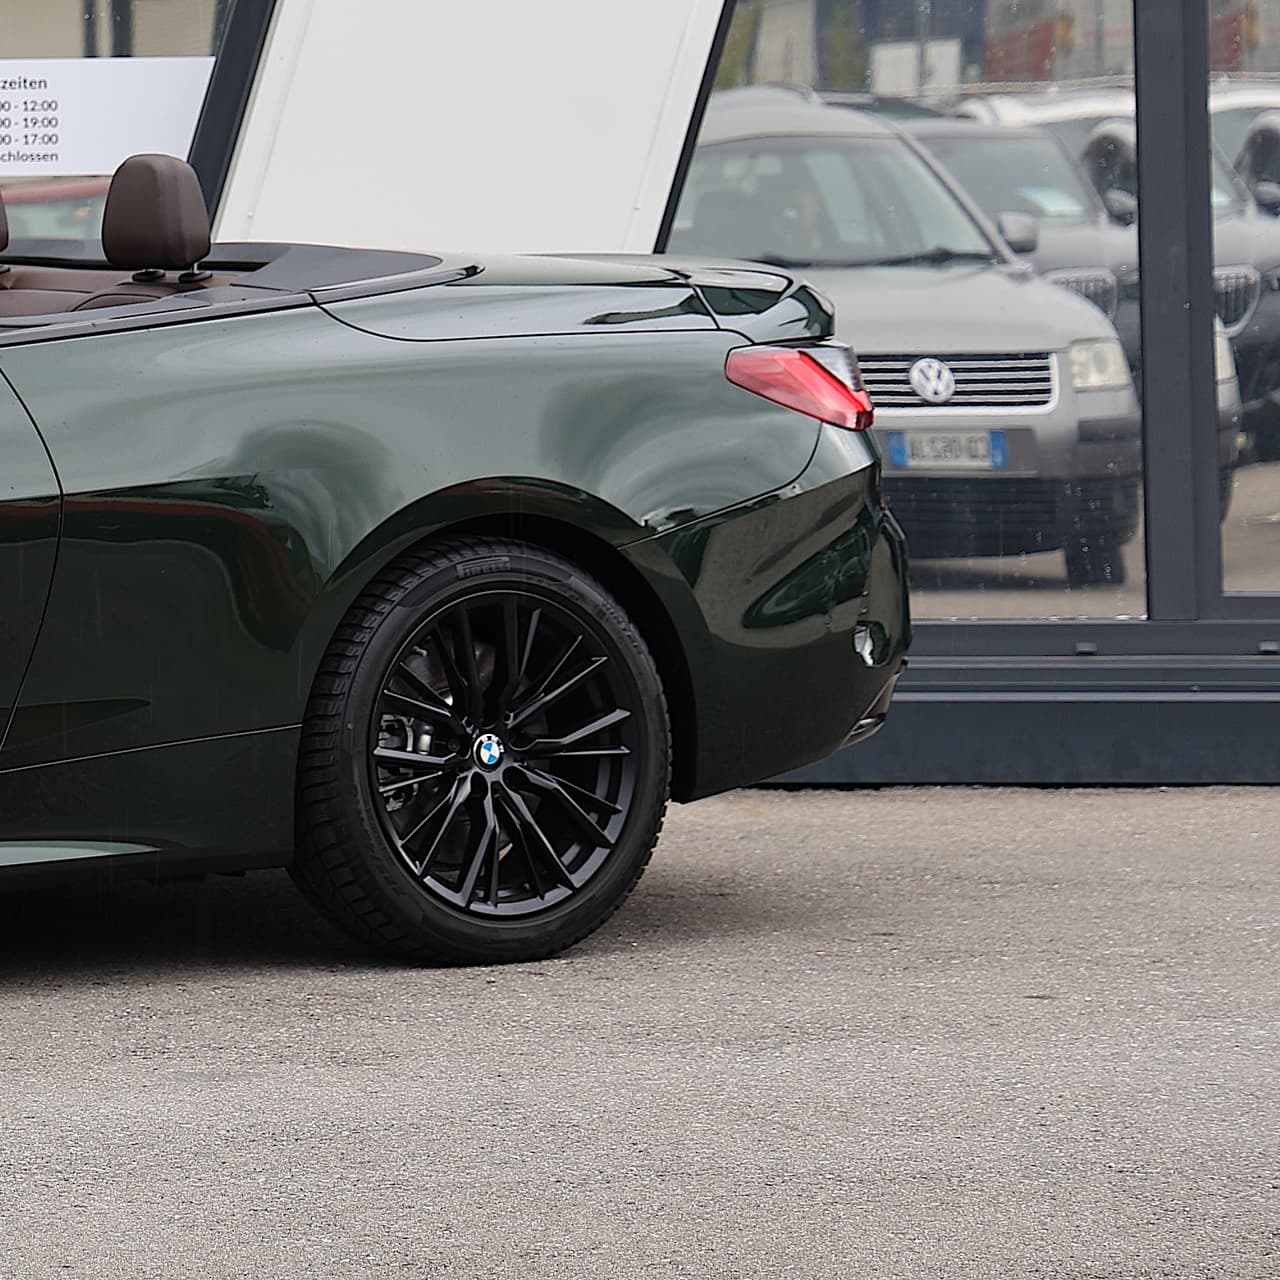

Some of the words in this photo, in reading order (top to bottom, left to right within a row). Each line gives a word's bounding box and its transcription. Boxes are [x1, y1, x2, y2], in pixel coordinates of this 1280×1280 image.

[23, 100, 58, 112] 12:00
[23, 117, 58, 129] 19:00
[23, 134, 58, 146] 17:00
